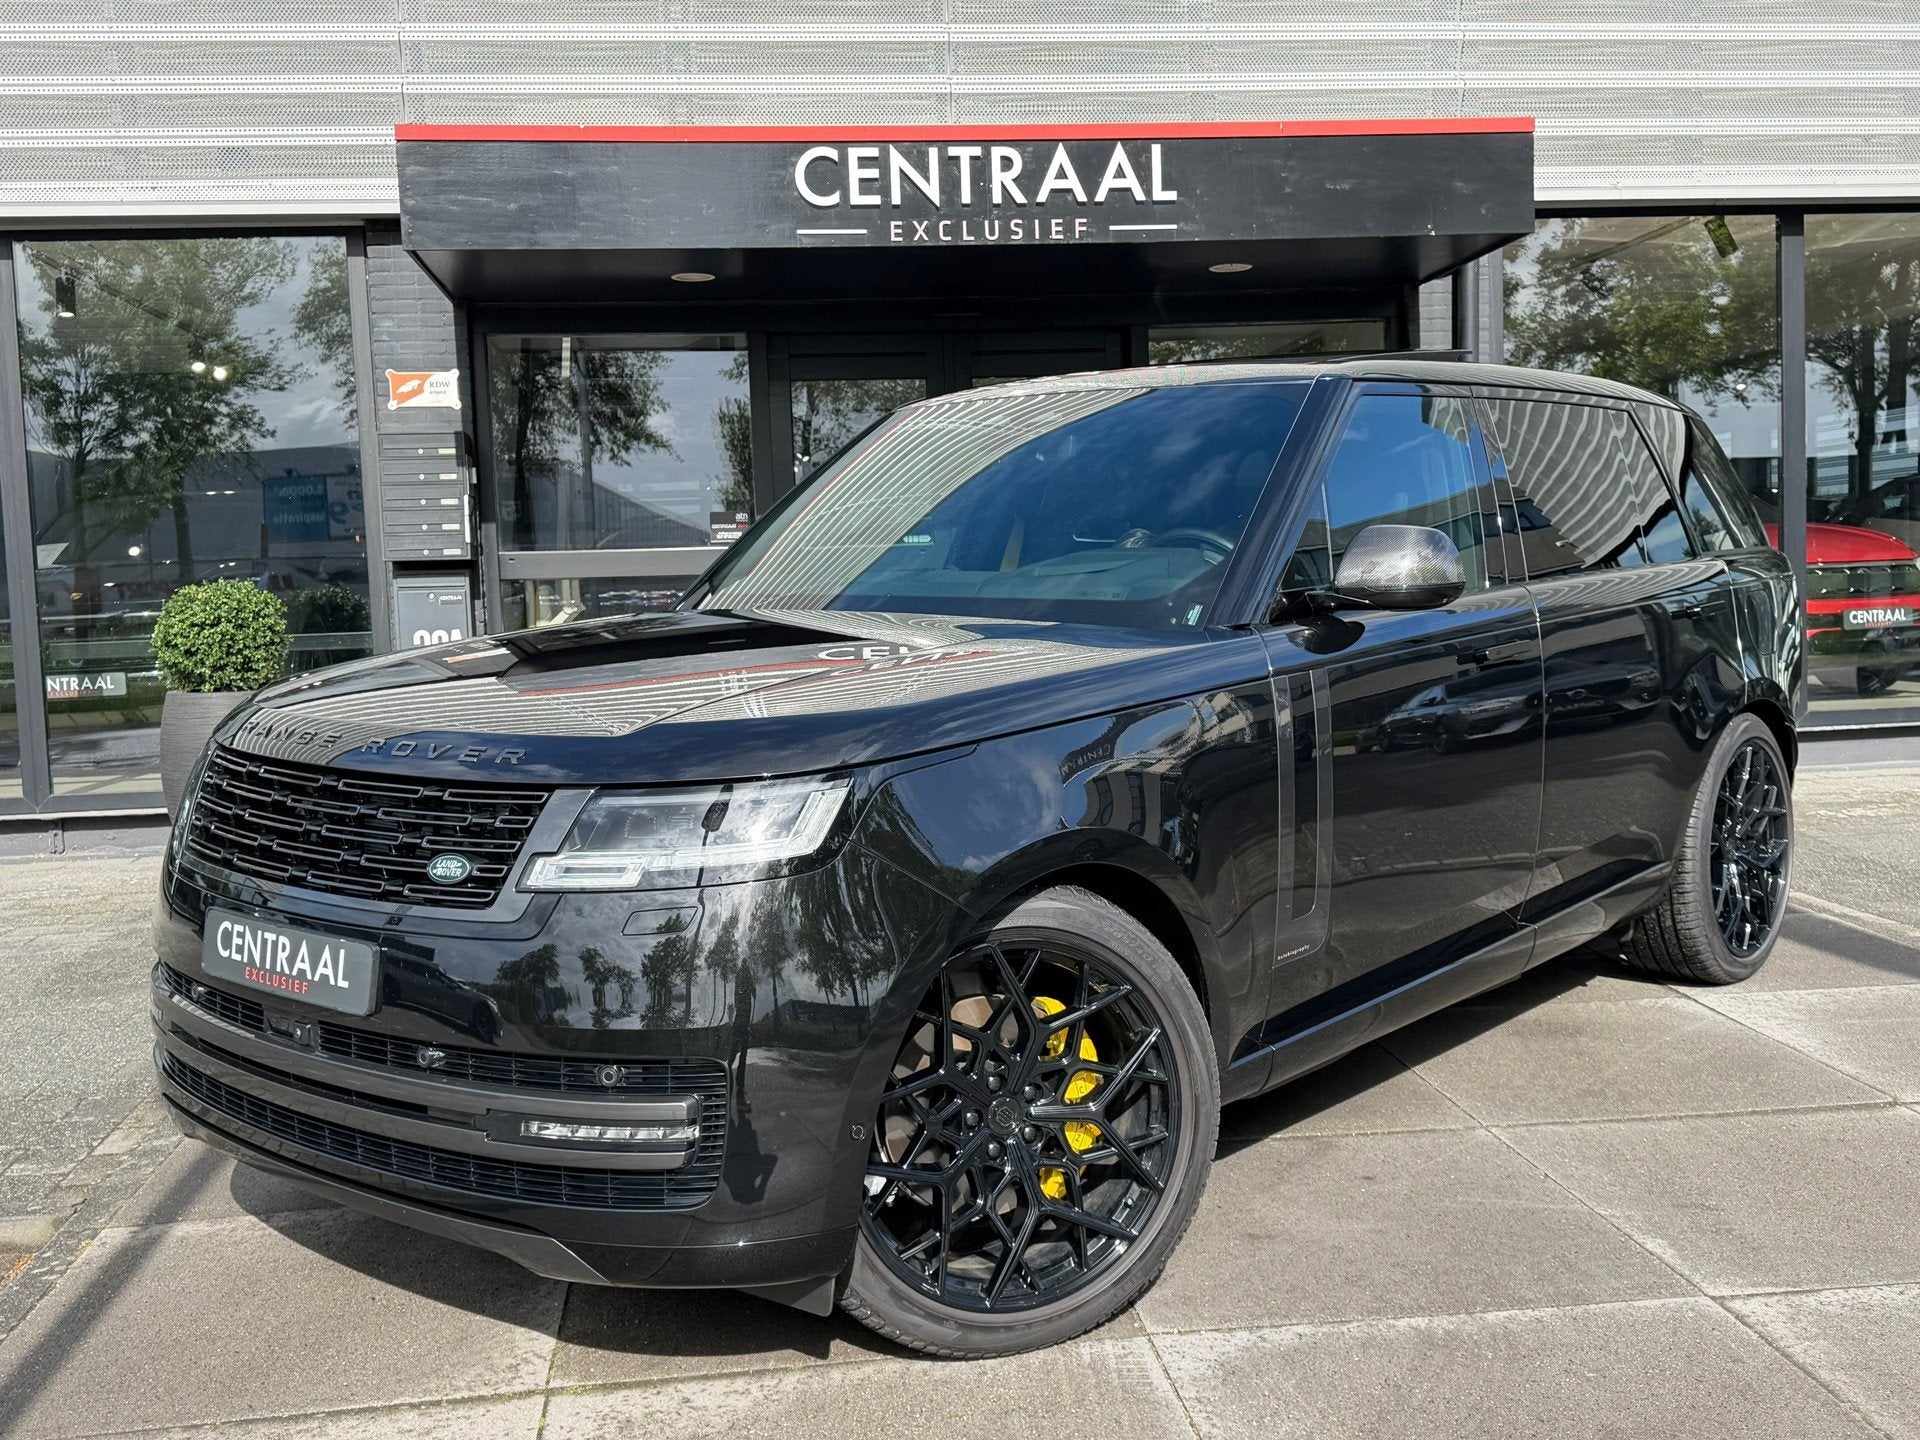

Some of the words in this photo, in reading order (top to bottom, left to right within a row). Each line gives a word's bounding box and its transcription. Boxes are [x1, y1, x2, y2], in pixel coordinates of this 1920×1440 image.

[794, 141, 1178, 208] CENTRAAL
[890, 217, 1088, 242] EXCLUSIEF
[1849, 608, 1907, 624] CENTRAAL
[46, 675, 115, 692] NTRAAL
[240, 721, 342, 748] RANGE
[362, 738, 527, 765] ROVER
[436, 859, 457, 867] LAND
[436, 868, 462, 876] ROVER
[217, 920, 349, 988] CENTRAAL
[244, 966, 310, 994] EXCLUSIEF
